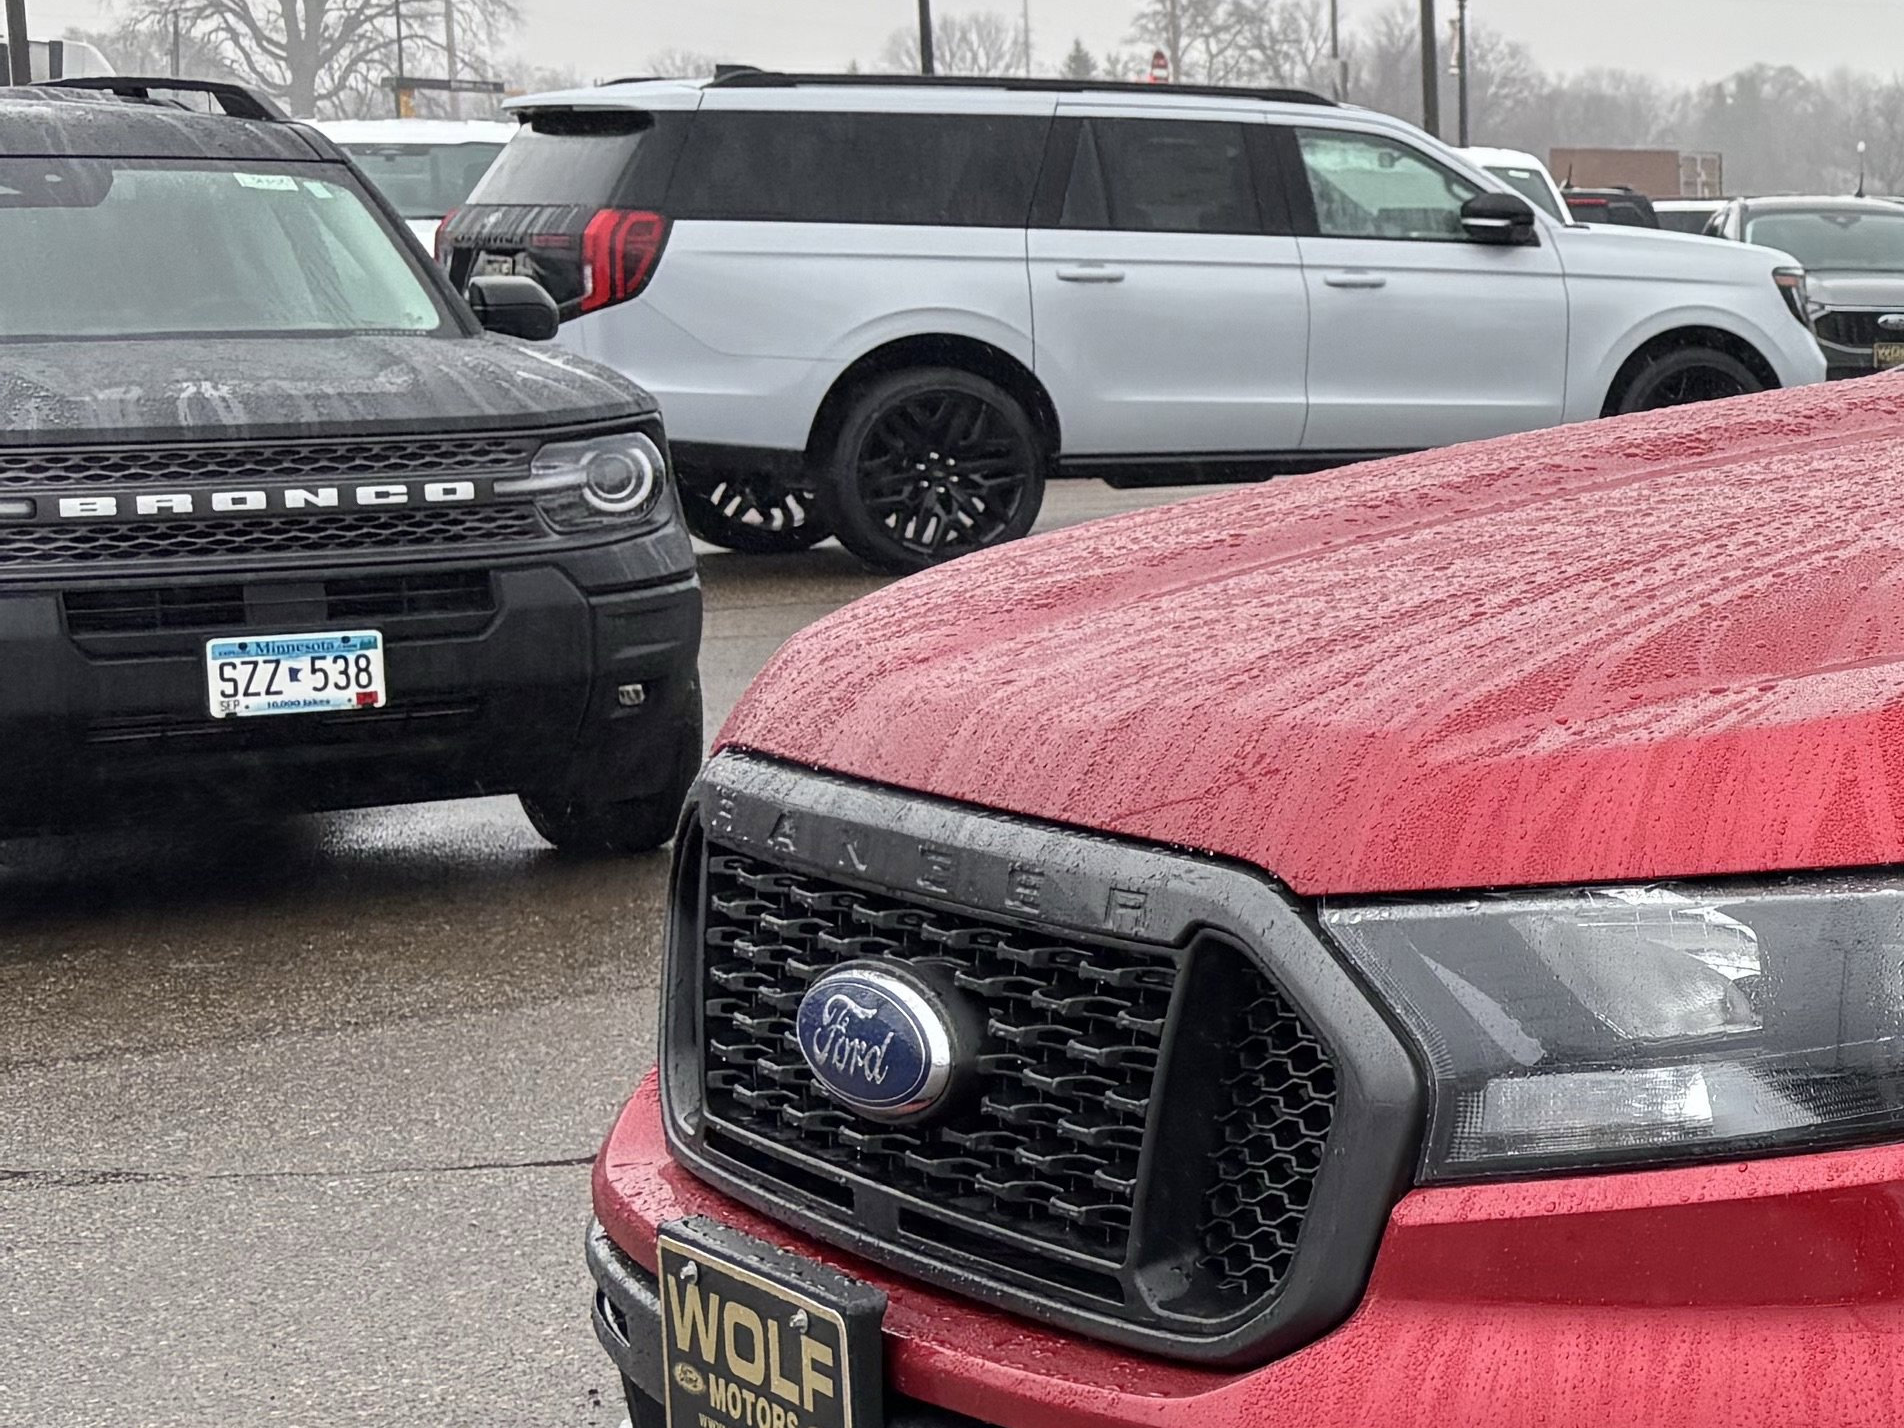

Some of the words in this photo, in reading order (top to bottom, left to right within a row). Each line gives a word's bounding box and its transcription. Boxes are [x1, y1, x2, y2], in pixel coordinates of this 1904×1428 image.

[58, 481, 475, 518] BRONCO
[255, 639, 335, 656] Minnesota
[218, 659, 284, 699] SZZ
[310, 653, 373, 692] 538
[220, 699, 240, 712] SEP
[812, 993, 895, 1085] Ford
[667, 1274, 835, 1413] WOLF
